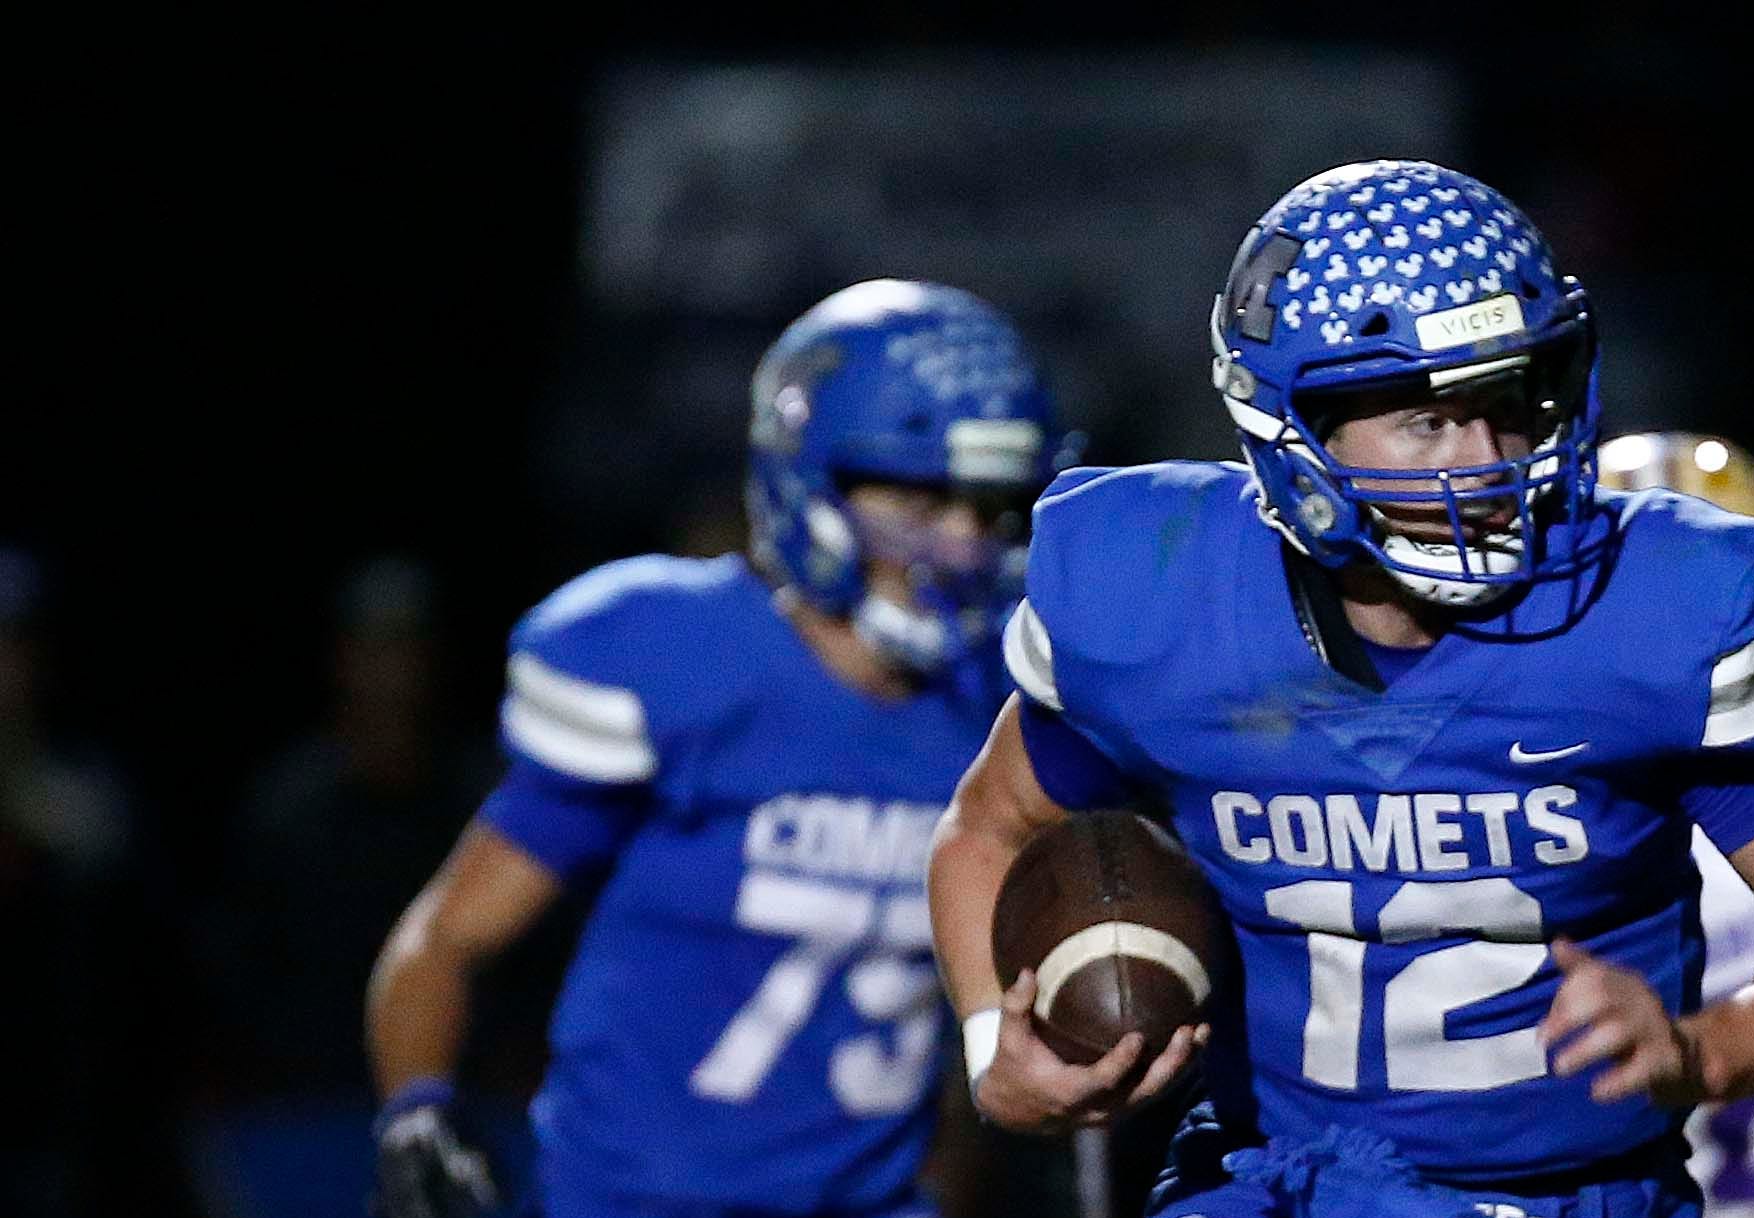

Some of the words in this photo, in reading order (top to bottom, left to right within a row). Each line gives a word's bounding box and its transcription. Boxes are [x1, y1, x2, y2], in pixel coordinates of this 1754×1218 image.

[1440, 307, 1504, 335] VICIS
[1211, 785, 1590, 872] COMETS
[1264, 877, 1551, 1092] 12
